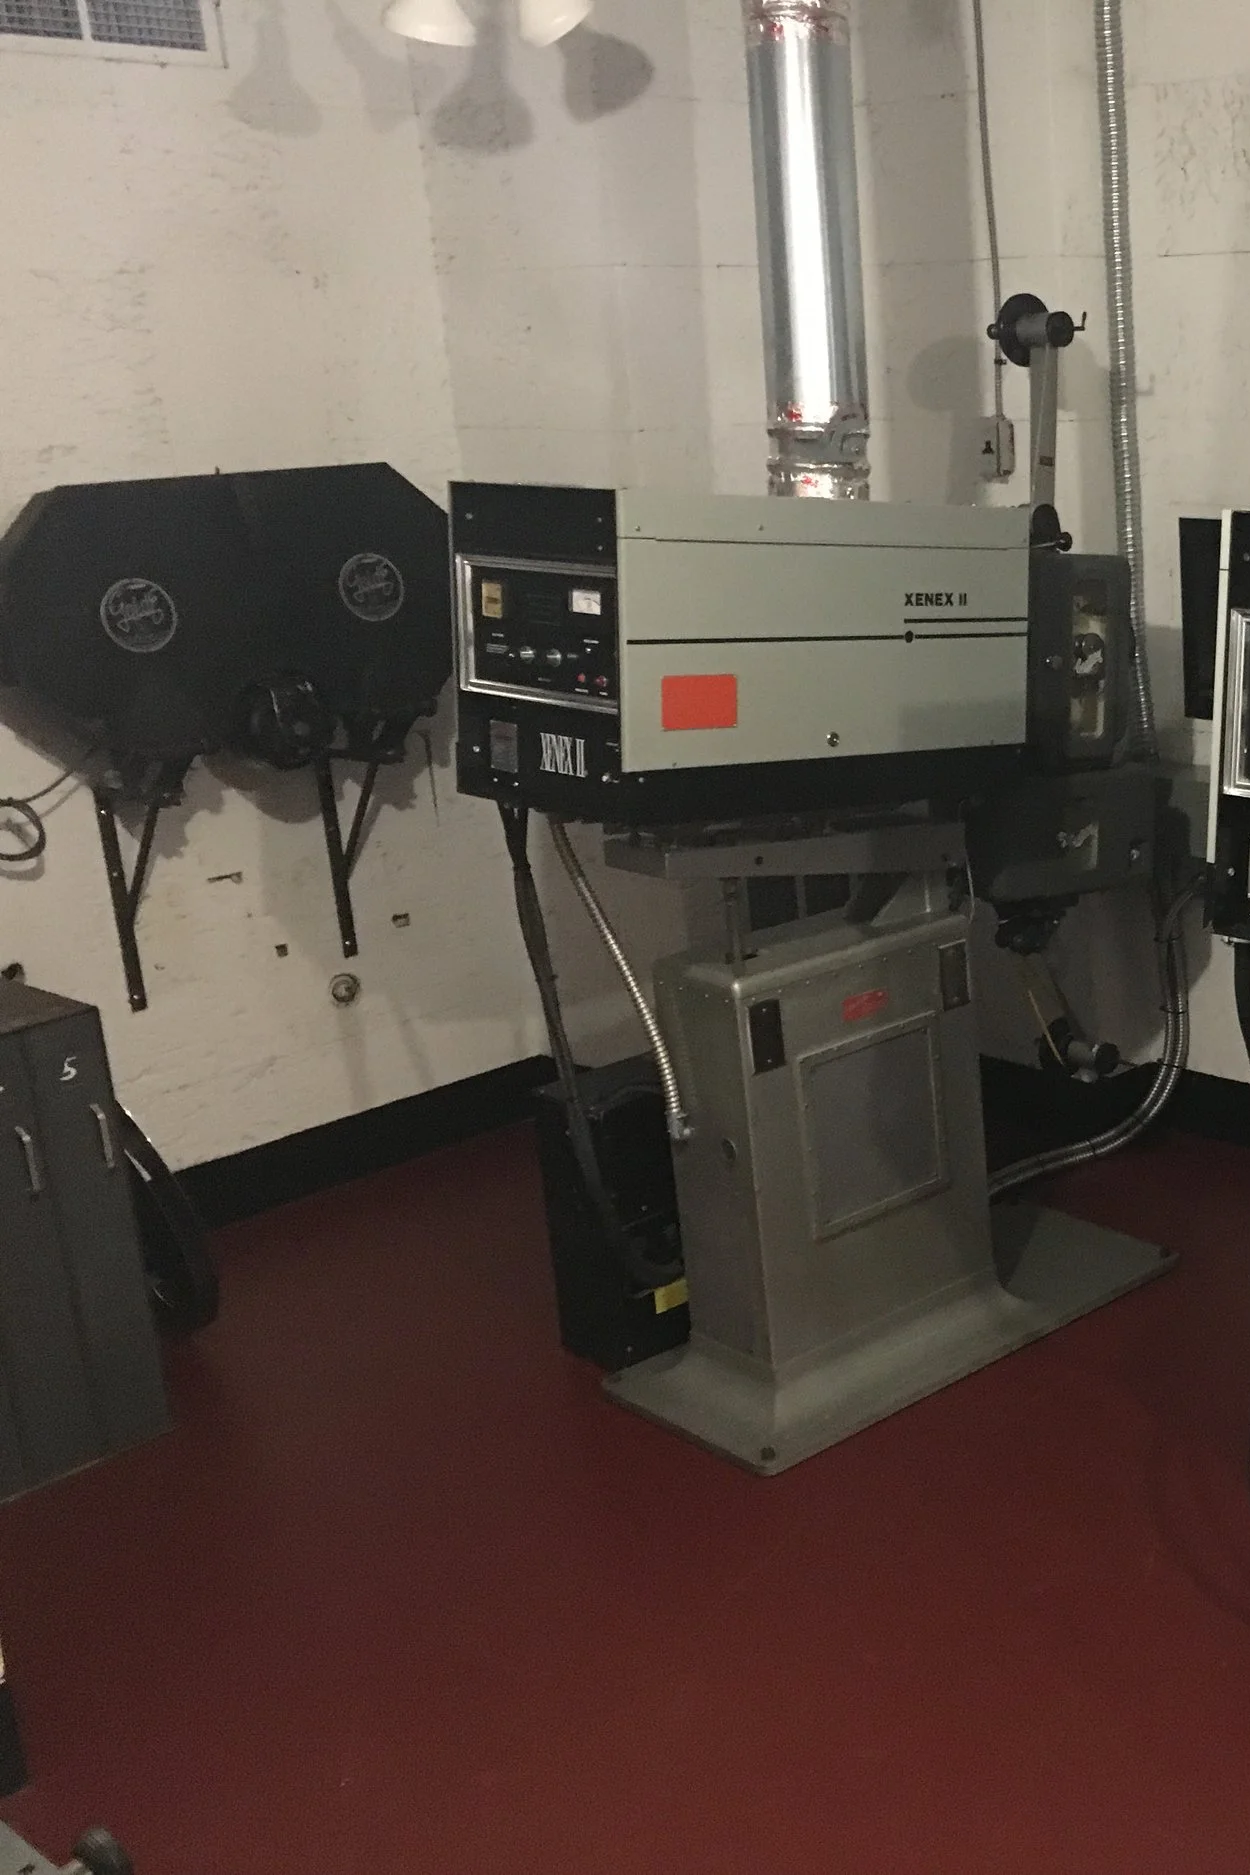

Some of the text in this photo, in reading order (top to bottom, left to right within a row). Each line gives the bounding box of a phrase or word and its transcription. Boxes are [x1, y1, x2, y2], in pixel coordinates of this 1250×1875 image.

[904, 592, 968, 607] XENEX II
[539, 732, 575, 776] XENEX
[59, 1056, 78, 1081] 5
